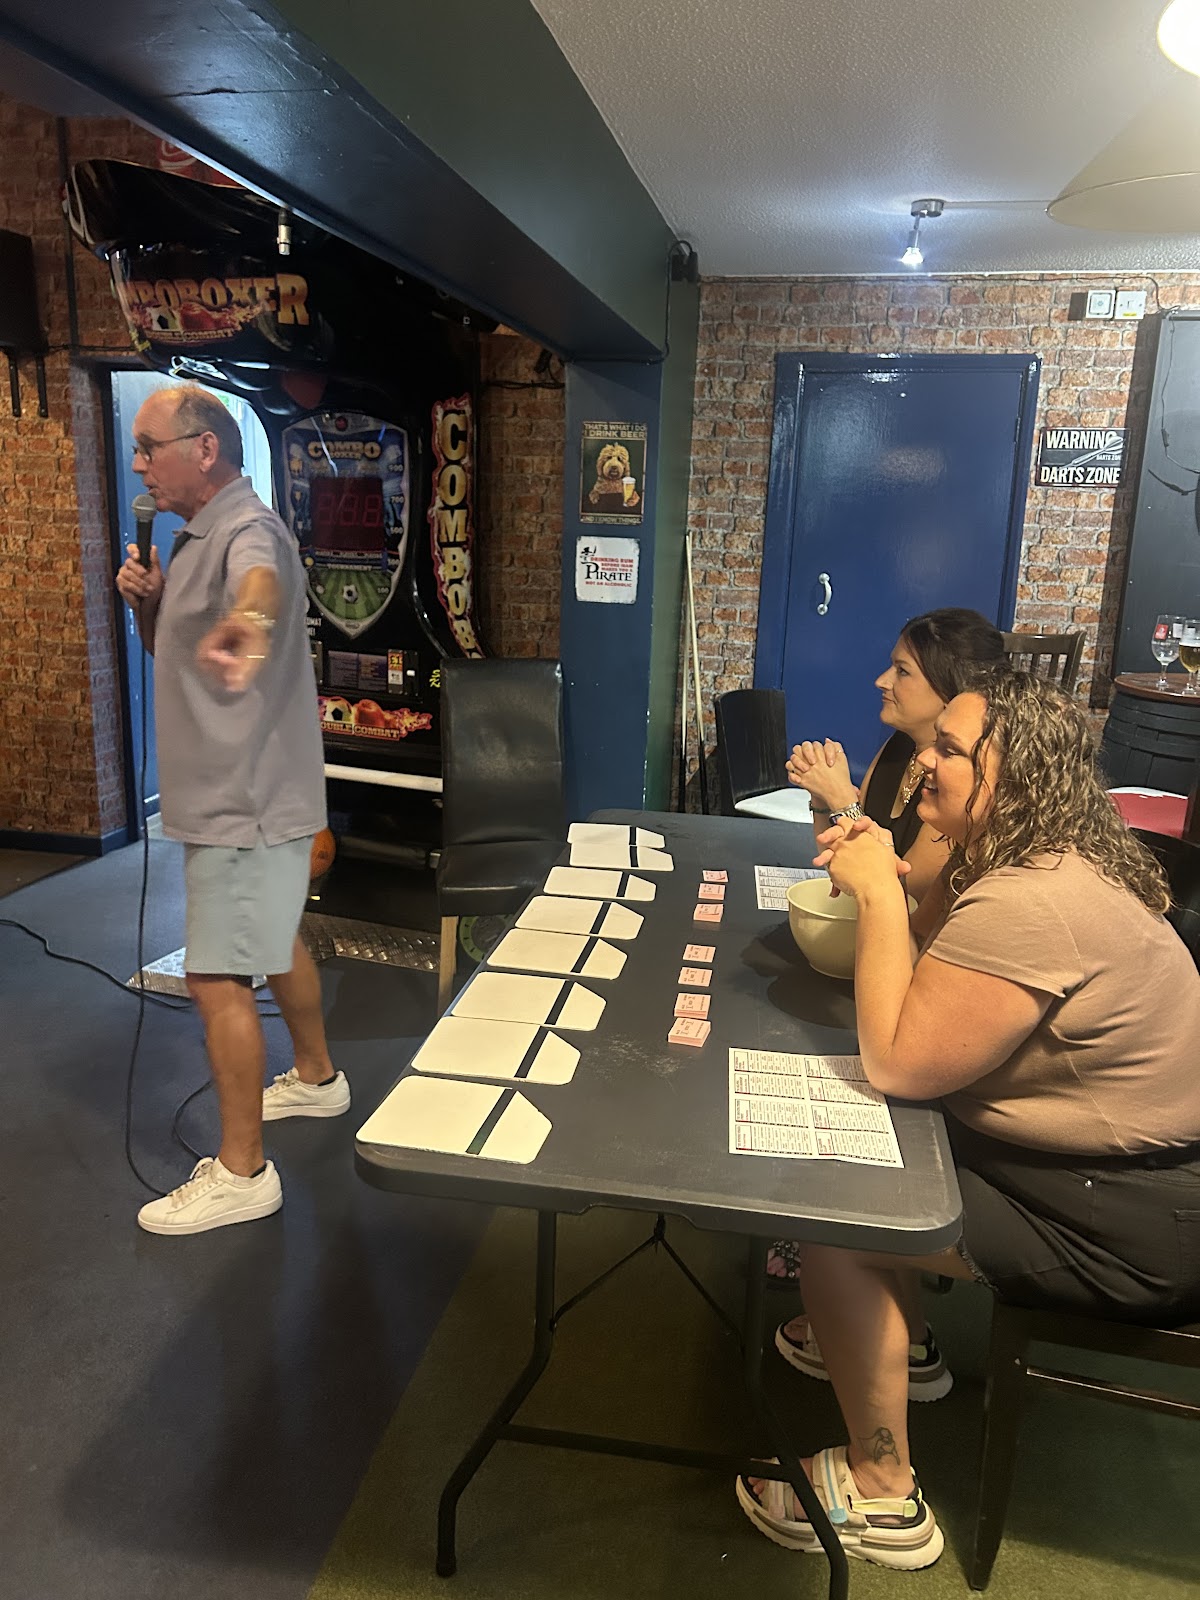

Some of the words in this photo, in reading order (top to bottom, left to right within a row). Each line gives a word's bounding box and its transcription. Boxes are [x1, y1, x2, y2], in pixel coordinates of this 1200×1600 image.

[589, 430, 619, 438] DRINK
[308, 441, 382, 459] COMBO
[1040, 466, 1085, 484] DARTS
[1085, 467, 1121, 484] ZONE
[580, 561, 632, 581] PIRATE
[320, 721, 352, 733] OUBLE
[354, 725, 400, 739] COMBAT
